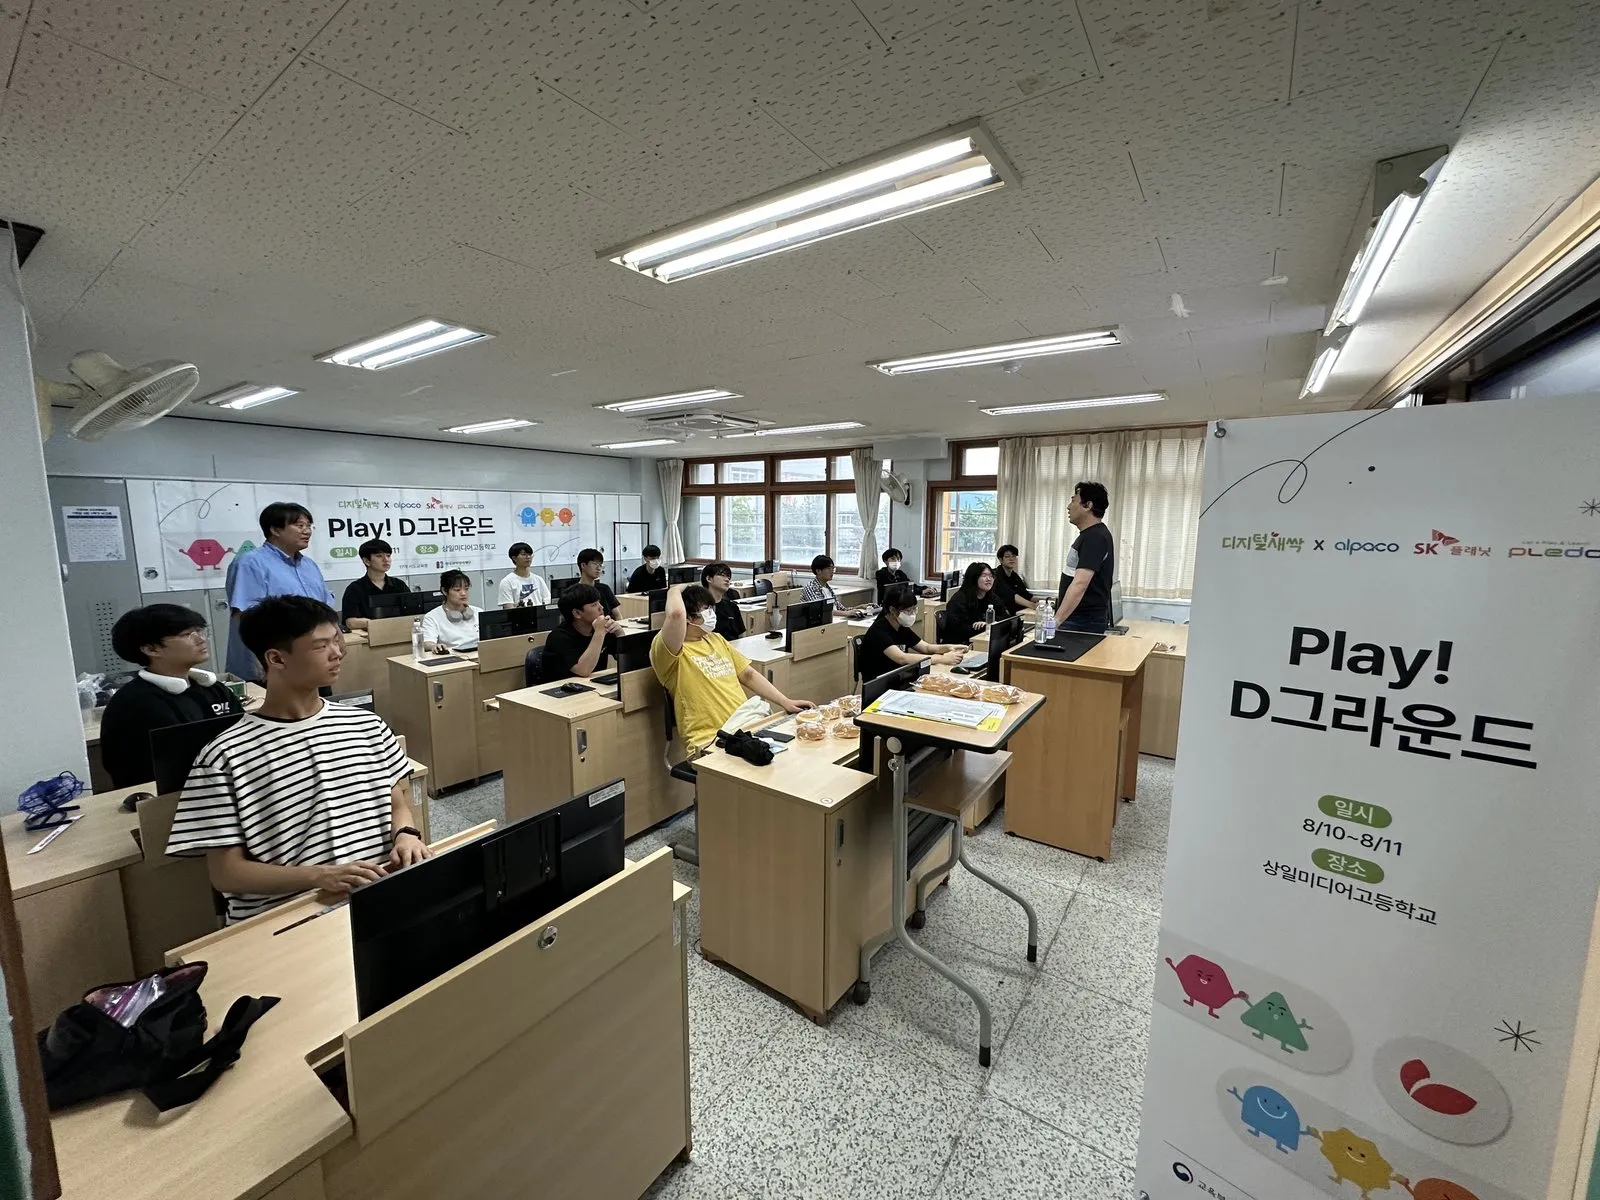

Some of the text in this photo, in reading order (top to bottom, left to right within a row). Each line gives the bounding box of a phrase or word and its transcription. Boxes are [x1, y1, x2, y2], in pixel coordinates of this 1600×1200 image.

[328, 516, 496, 540] Play! D그라운드
[442, 544, 496, 552] 상일미디어고등학교
[1222, 533, 1304, 553] 디지털새싹
[1334, 538, 1399, 555] alpaco
[1413, 543, 1439, 555] SK
[1289, 626, 1453, 690] Play!
[1230, 680, 1538, 770] D그라운드
[1335, 800, 1374, 825] 일시
[1302, 818, 1403, 856] 8/10~8/11
[1327, 853, 1367, 878] 장소
[1262, 859, 1438, 926] 상일미디어고등학교
